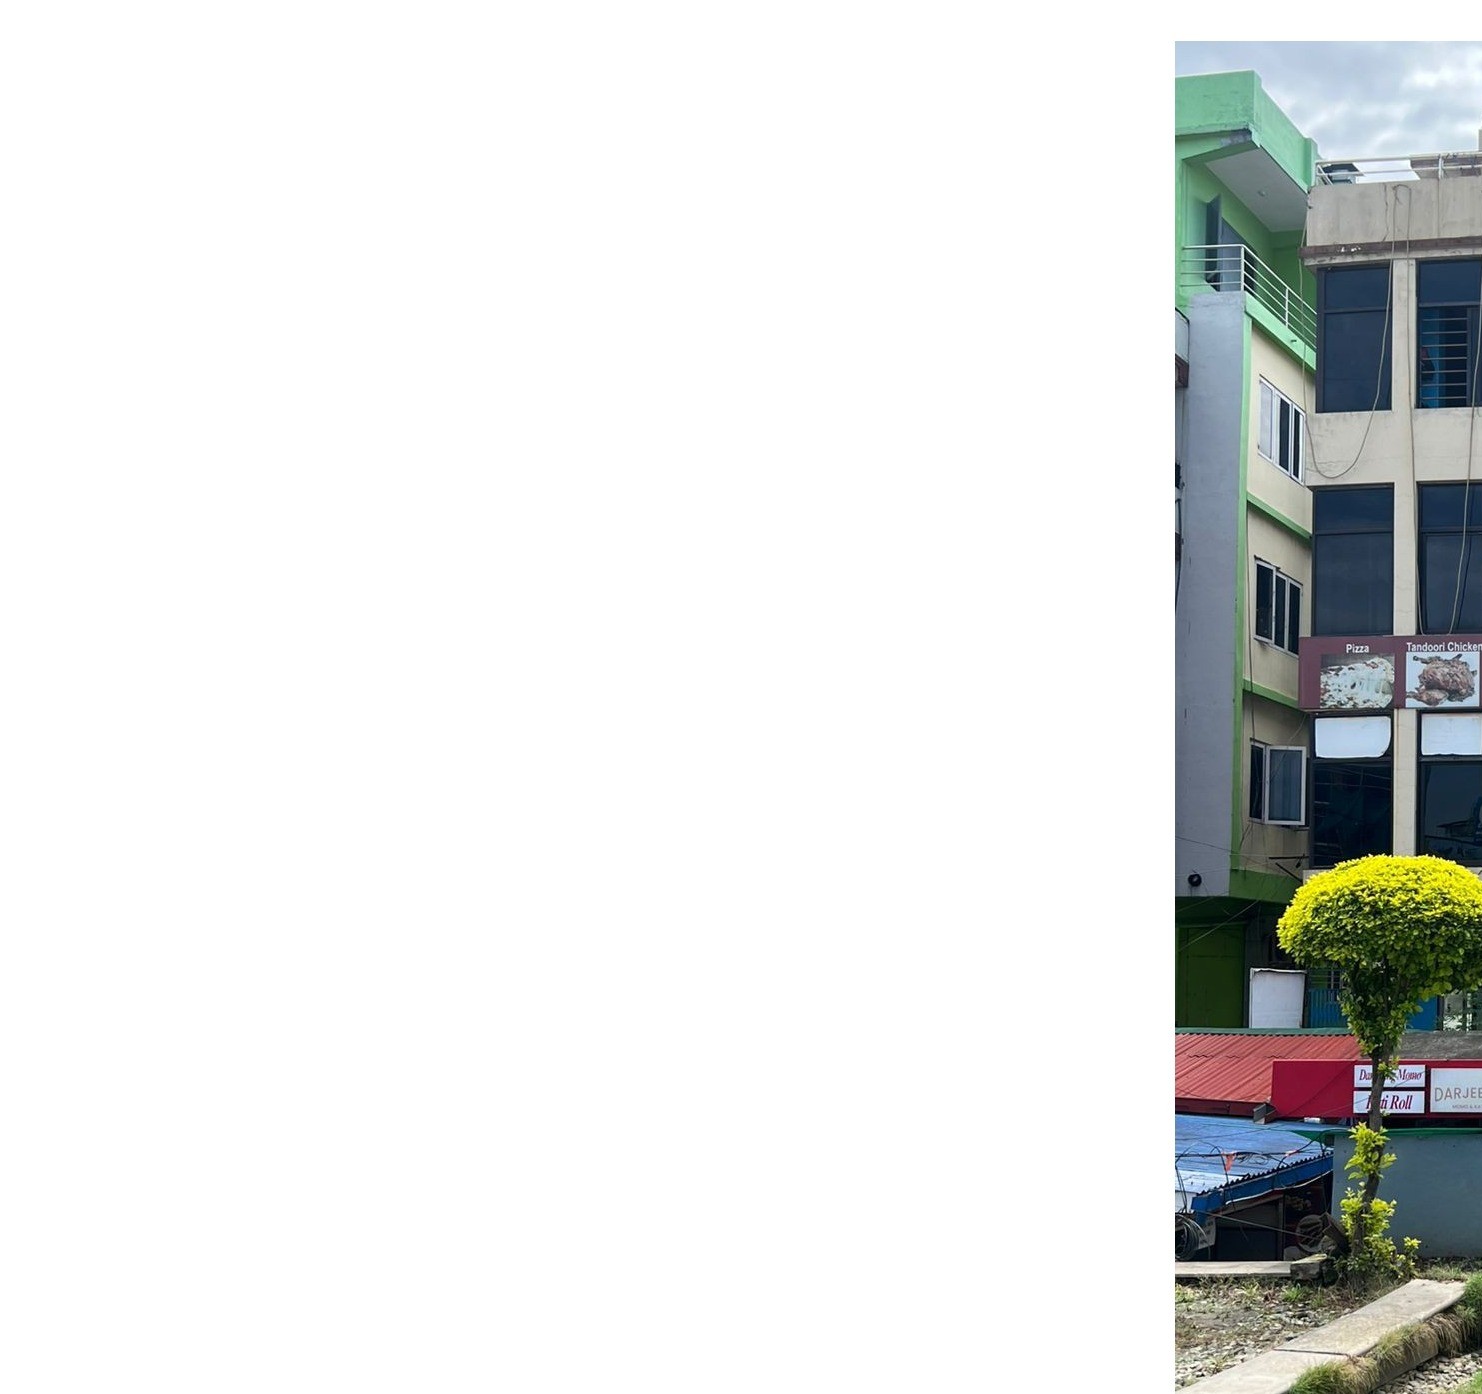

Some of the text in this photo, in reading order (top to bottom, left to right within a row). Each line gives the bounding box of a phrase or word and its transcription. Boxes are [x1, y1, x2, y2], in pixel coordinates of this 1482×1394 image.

[1346, 643, 1369, 653] Pizza
[1406, 642, 1445, 651] Tandoori
[1390, 1095, 1413, 1109] Roll
